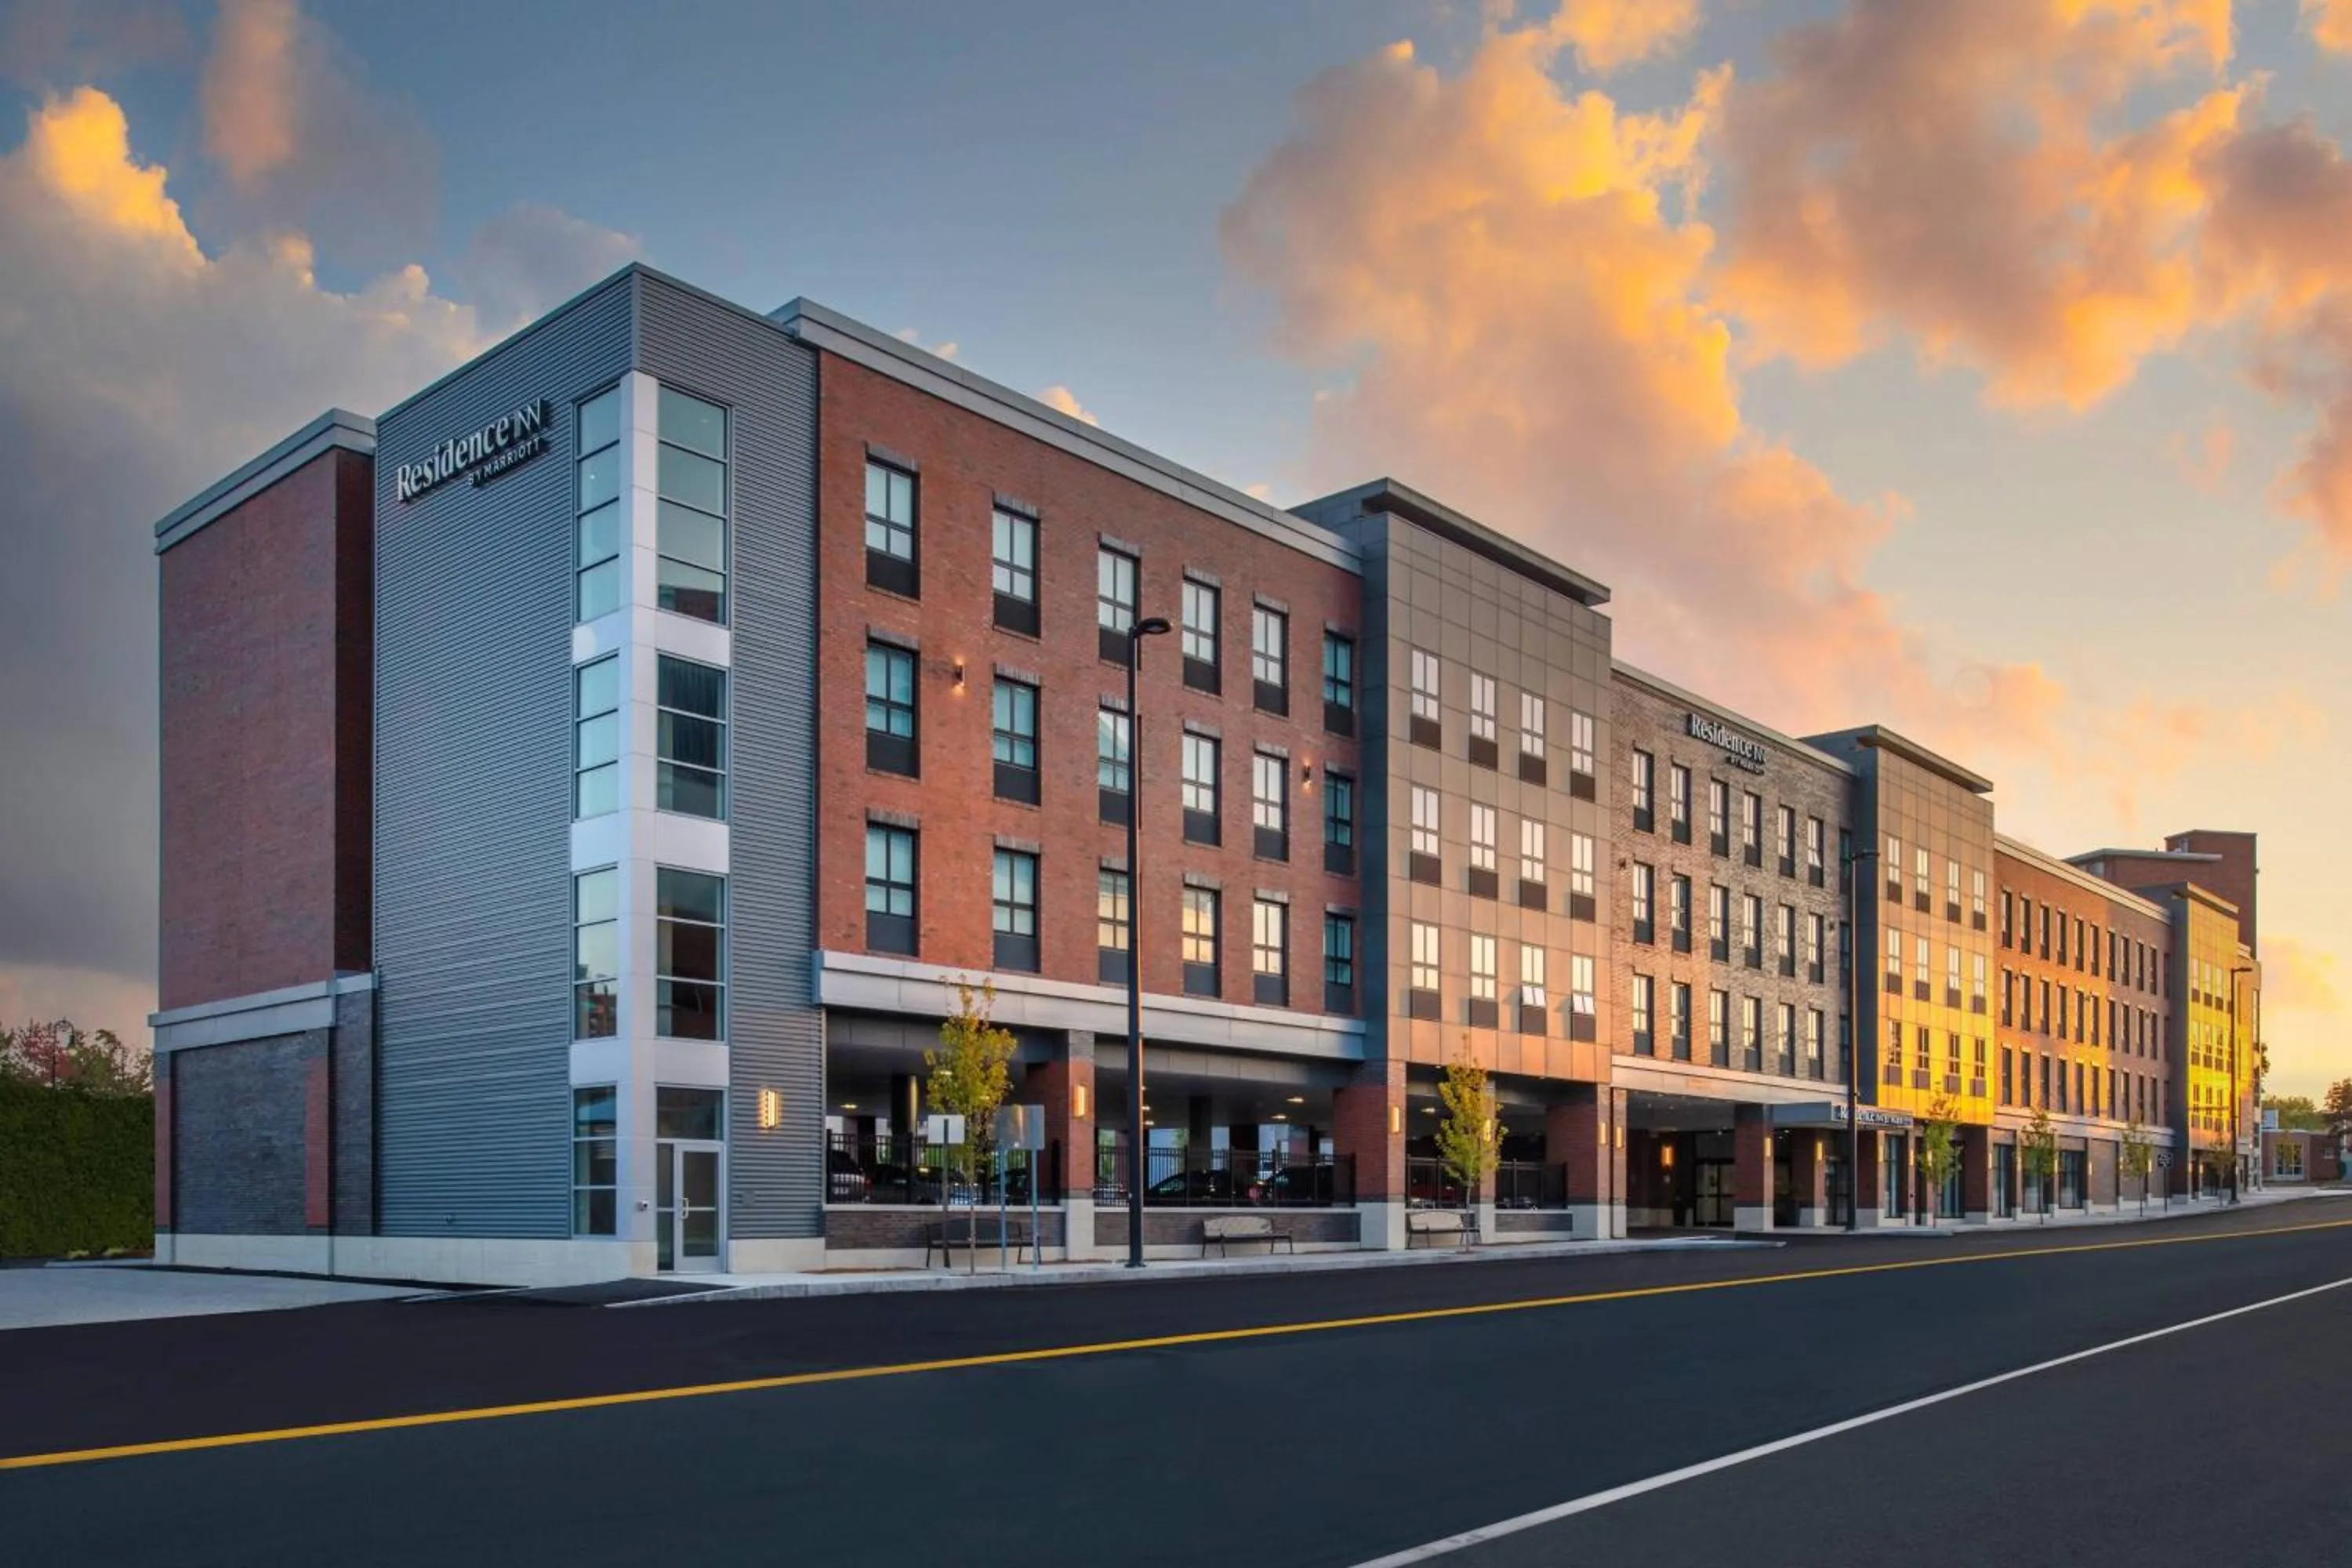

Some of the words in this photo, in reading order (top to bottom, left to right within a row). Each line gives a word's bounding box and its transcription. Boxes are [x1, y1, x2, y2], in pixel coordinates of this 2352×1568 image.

[397, 416, 510, 501] Residence
[484, 437, 540, 477] MARRIOTT
[1692, 713, 1752, 757] Residence
